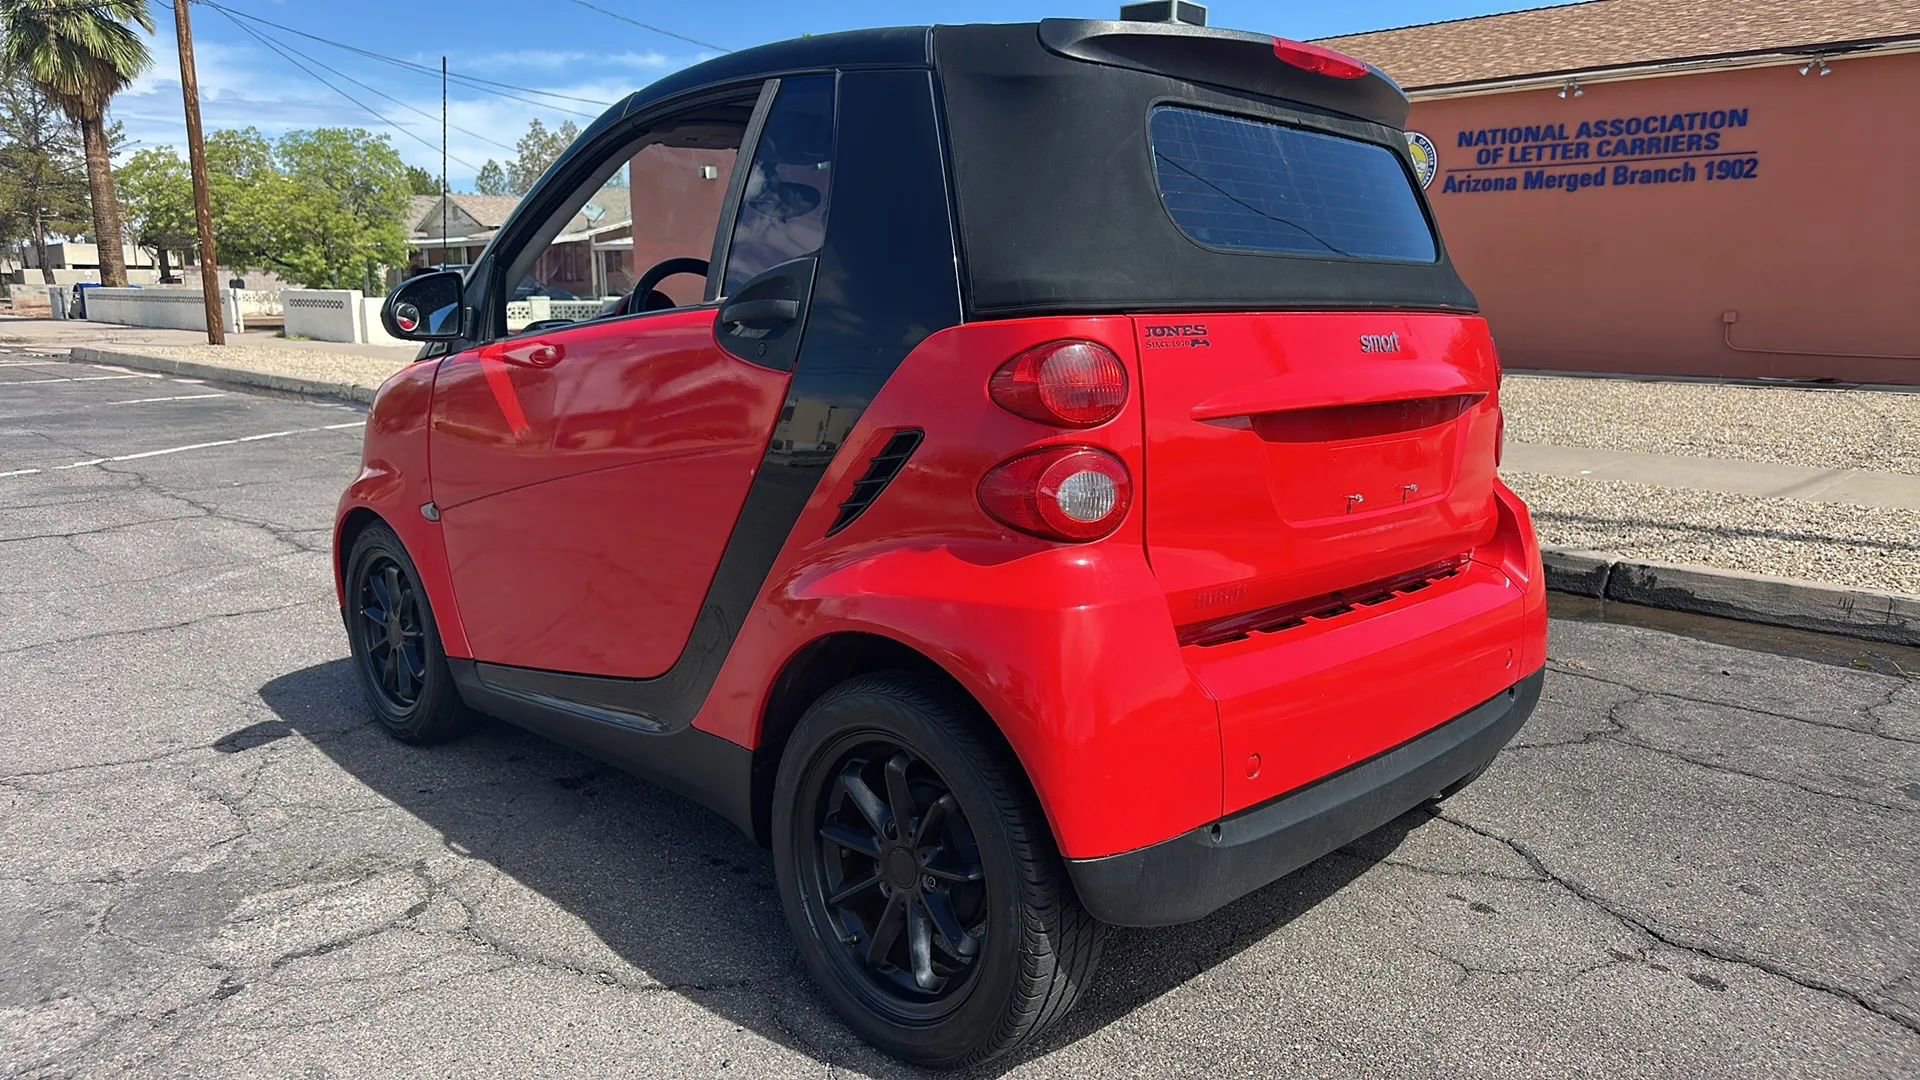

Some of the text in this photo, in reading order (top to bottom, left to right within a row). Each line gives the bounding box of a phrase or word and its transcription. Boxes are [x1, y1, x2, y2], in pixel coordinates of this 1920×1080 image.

[1457, 108, 1749, 148] NATIONAL ASSOCIATION
[1476, 132, 1721, 165] OF LETTER CARRIERS
[1442, 158, 1758, 194] Arizona Merged Branch 1902
[1145, 325, 1208, 338] JONES
[1360, 332, 1400, 353] smart
